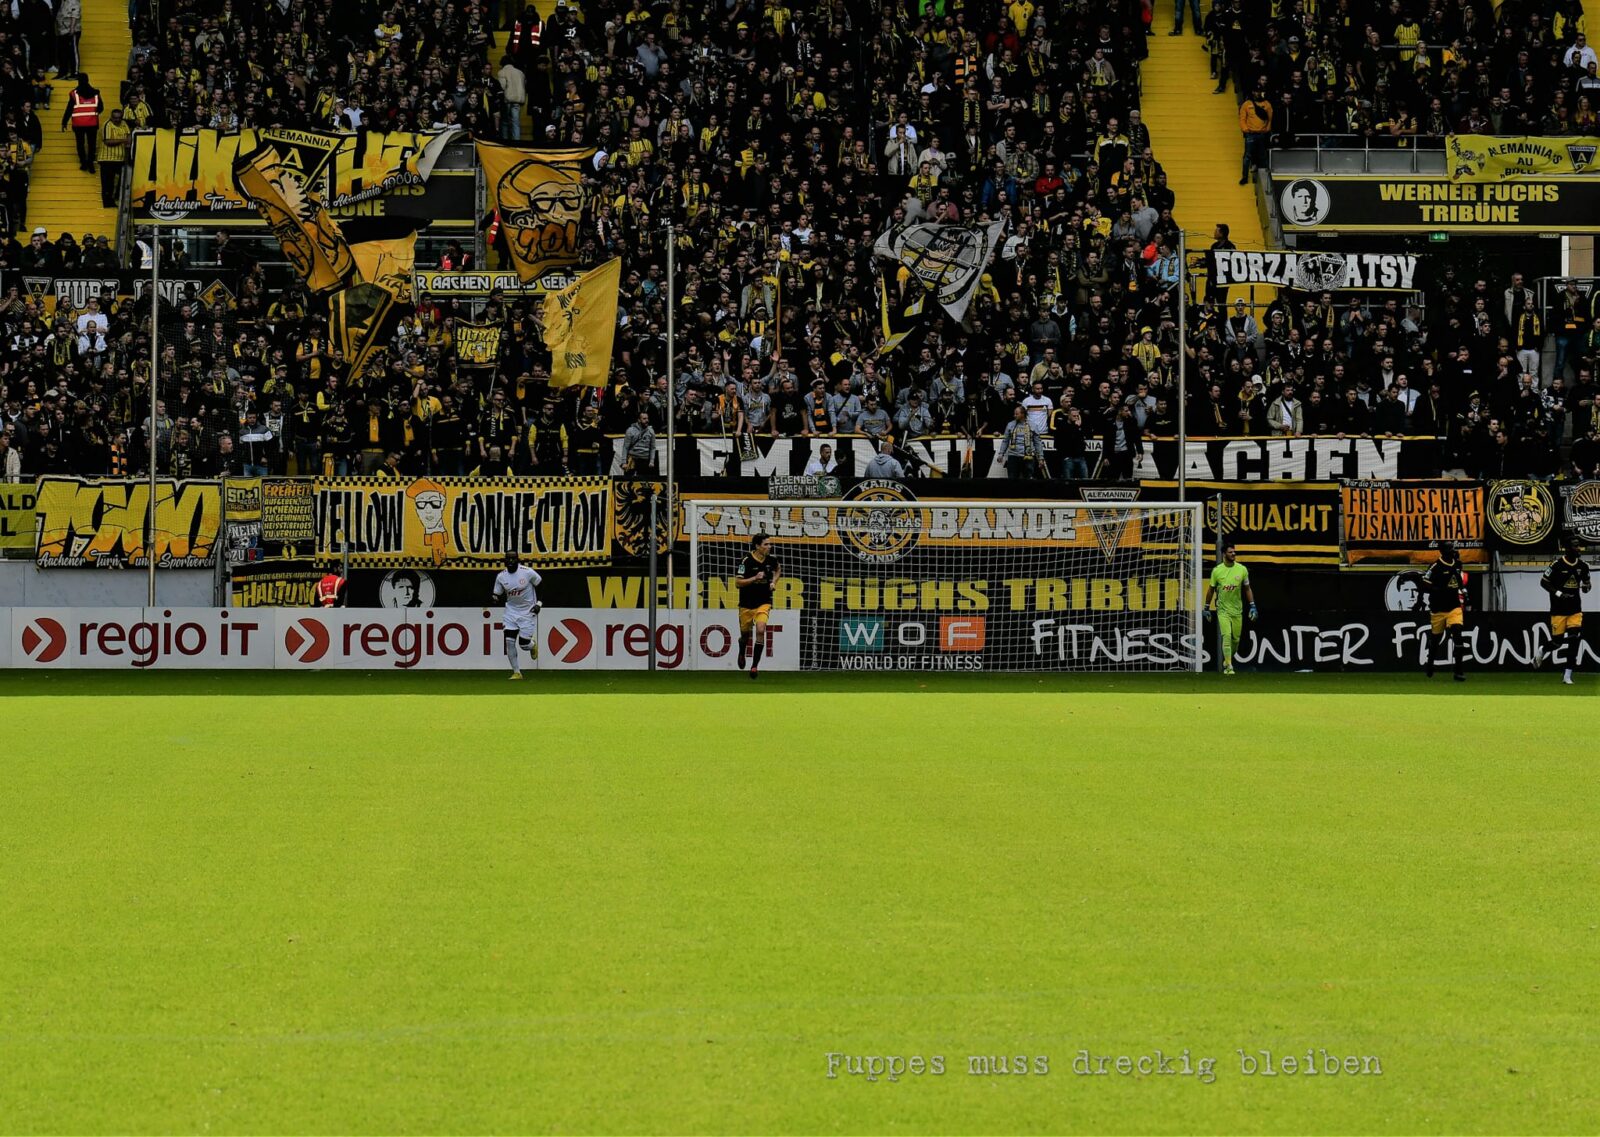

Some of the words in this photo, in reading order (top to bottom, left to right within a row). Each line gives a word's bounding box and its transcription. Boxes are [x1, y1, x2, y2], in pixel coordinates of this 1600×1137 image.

[1517, 157, 1534, 167] AU
[153, 193, 202, 211] Aachener
[205, 193, 242, 211] Turn-
[1379, 183, 1477, 202] WERNER
[1483, 183, 1560, 202] FUCHS
[1419, 202, 1520, 222] TRIBÜNE
[1215, 250, 1297, 287] FORZA
[1342, 252, 1417, 289] ATSV
[432, 275, 490, 291] AACHEN
[494, 275, 537, 291] ALLS
[541, 275, 580, 291] GEBE
[1042, 440, 1103, 450] ALNIA
[264, 484, 311, 497] FREIHEIT
[859, 479, 905, 493] KARLS
[1087, 491, 1133, 499] ALEMANNIA
[1350, 488, 1479, 514] FREUNDSCHAFT
[314, 488, 405, 554] YELLOW
[452, 488, 608, 554] CONNECTION
[683, 503, 829, 538] KARLS
[930, 507, 1076, 540] BANDE
[1240, 503, 1333, 532] WACHT
[1347, 513, 1481, 540] ZUSAMMENHALT
[37, 551, 86, 568] Aachener
[91, 550, 129, 568] Turn-
[135, 553, 152, 568] un
[858, 550, 902, 563] BANDE
[586, 576, 804, 609] WERNR
[820, 578, 990, 611] FUCHS
[79, 609, 207, 668] regio
[342, 609, 470, 668] regio
[482, 609, 506, 657] i
[605, 622, 732, 669] rego
[1031, 618, 1211, 665] FITNESS
[840, 655, 892, 671] WORLD
[898, 655, 918, 671] OF
[922, 655, 982, 671] FITNESS
